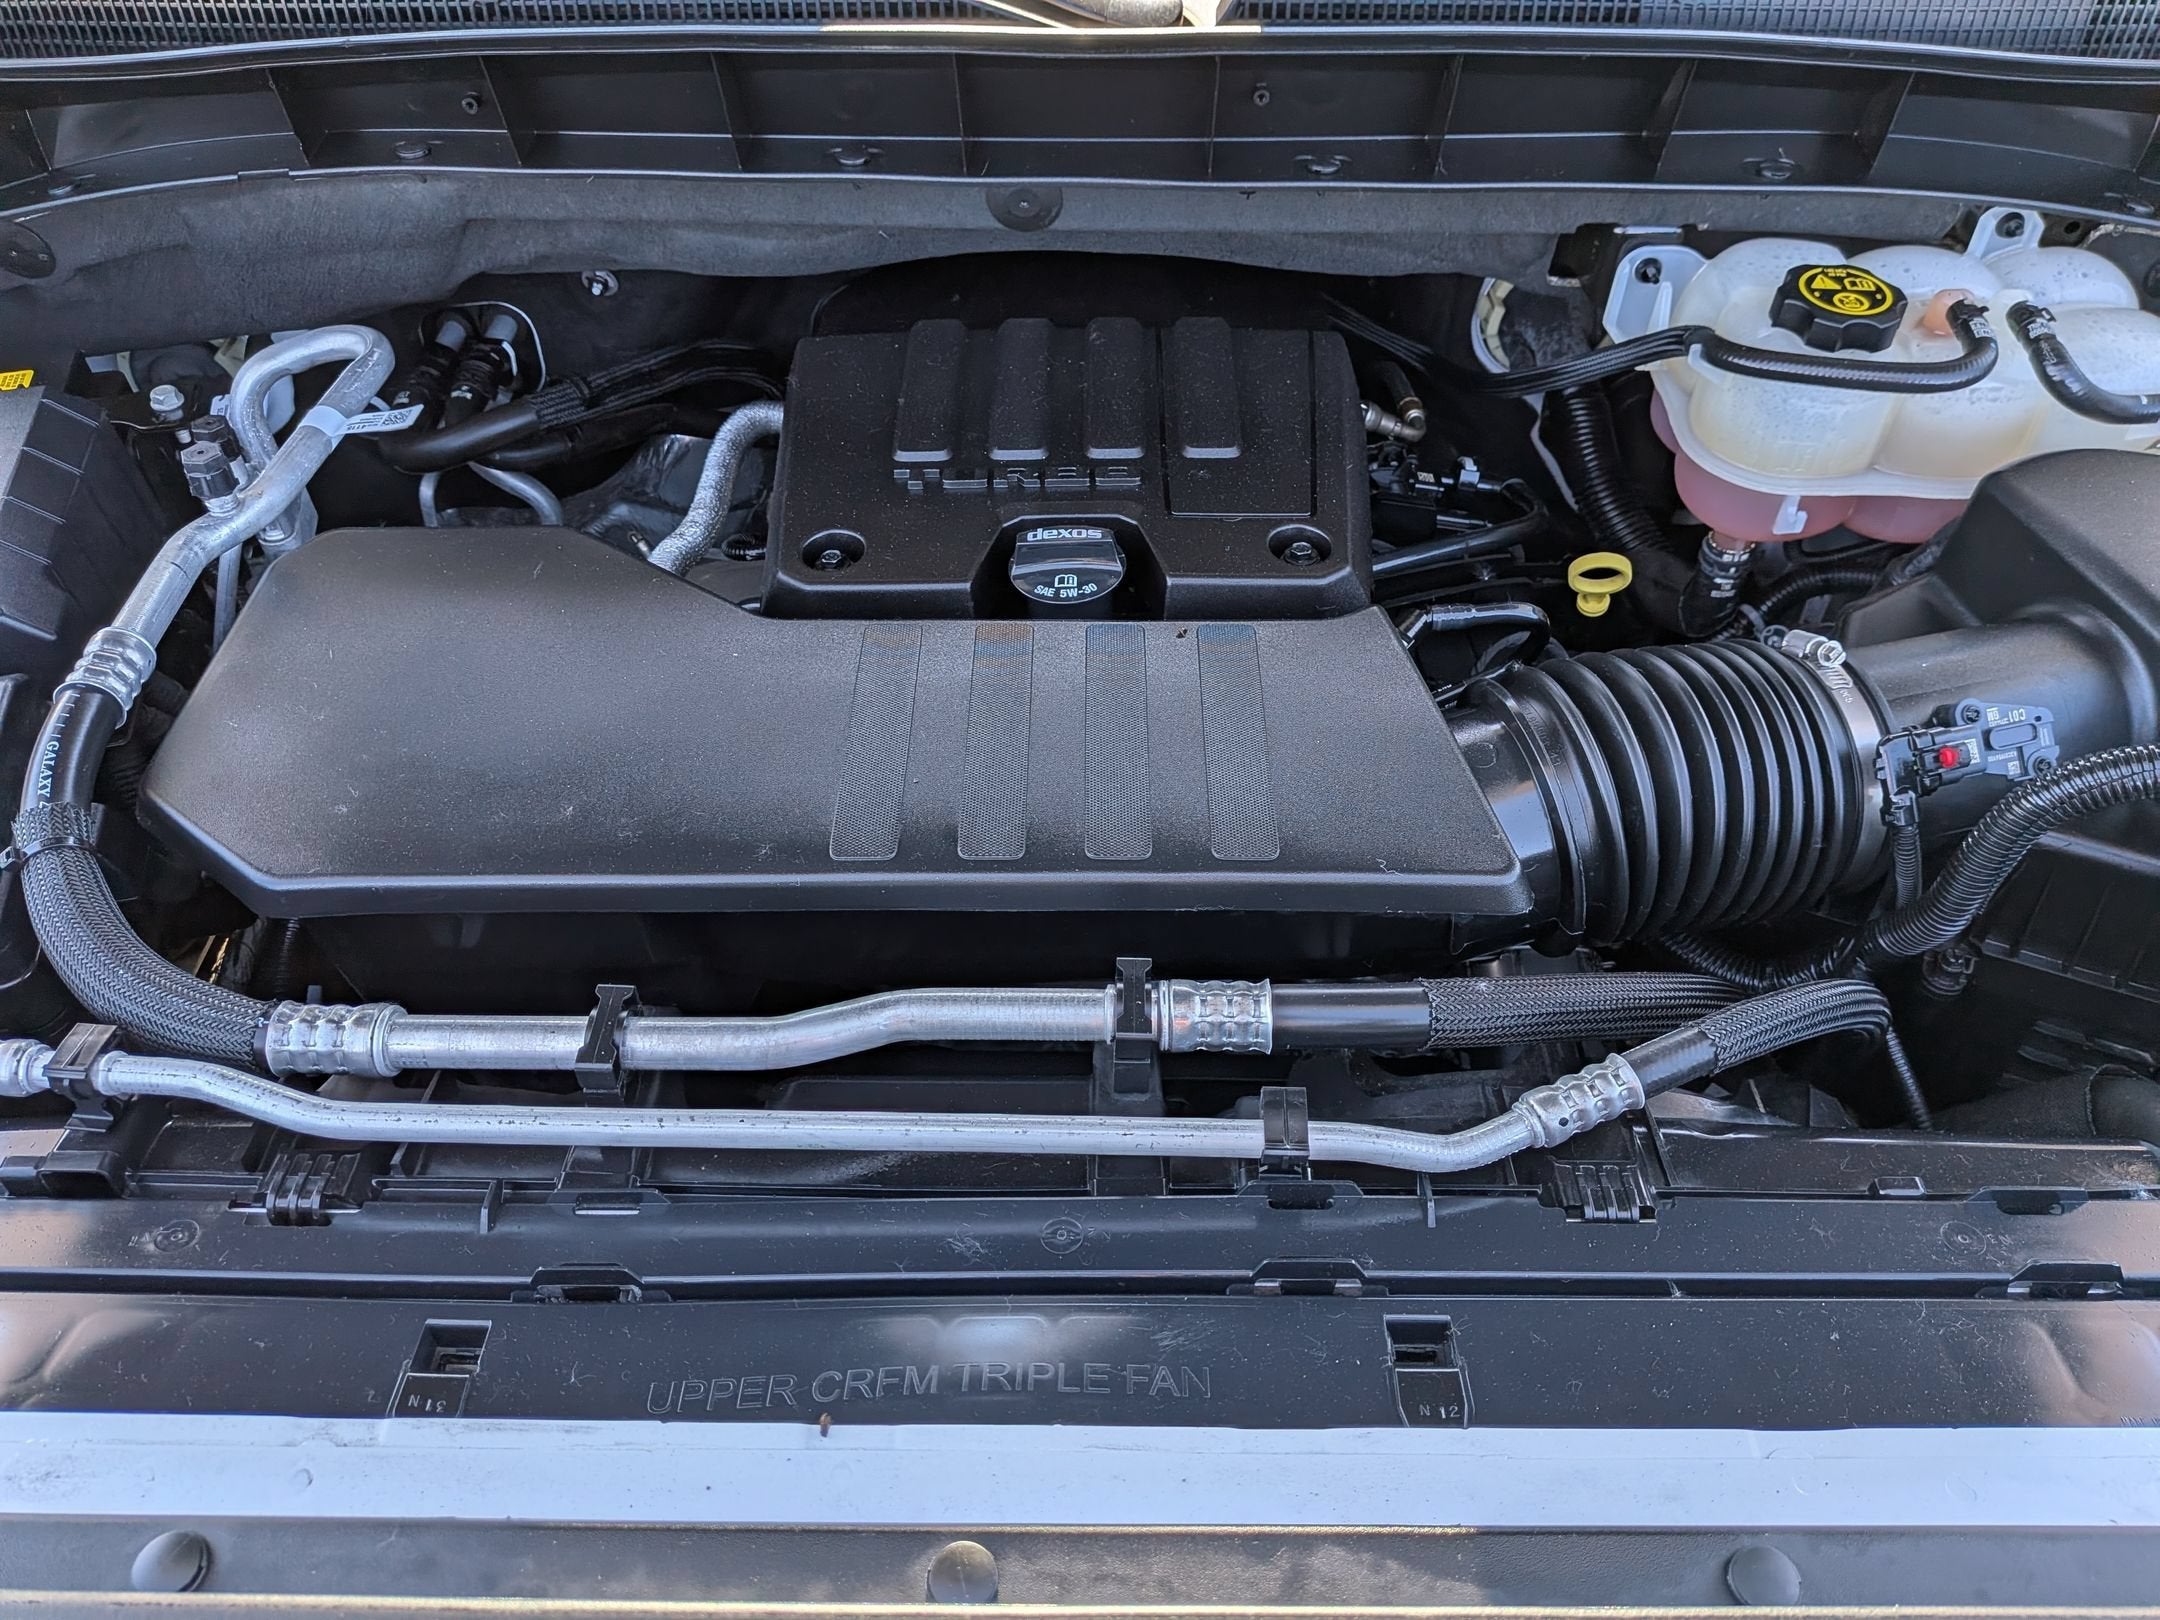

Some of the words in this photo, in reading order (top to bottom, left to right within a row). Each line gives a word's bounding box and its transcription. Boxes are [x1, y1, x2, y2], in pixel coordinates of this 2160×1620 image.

[1026, 528, 1103, 541] dexos
[1034, 584, 1055, 598] SAE
[1059, 583, 1098, 598] 5W-30
[37, 740, 60, 798] GALAXY
[647, 1374, 798, 1414] UPPER
[811, 1364, 940, 1403] CRFM
[952, 1362, 1112, 1394] TRIPLE
[1126, 1363, 1211, 1398] FAN
